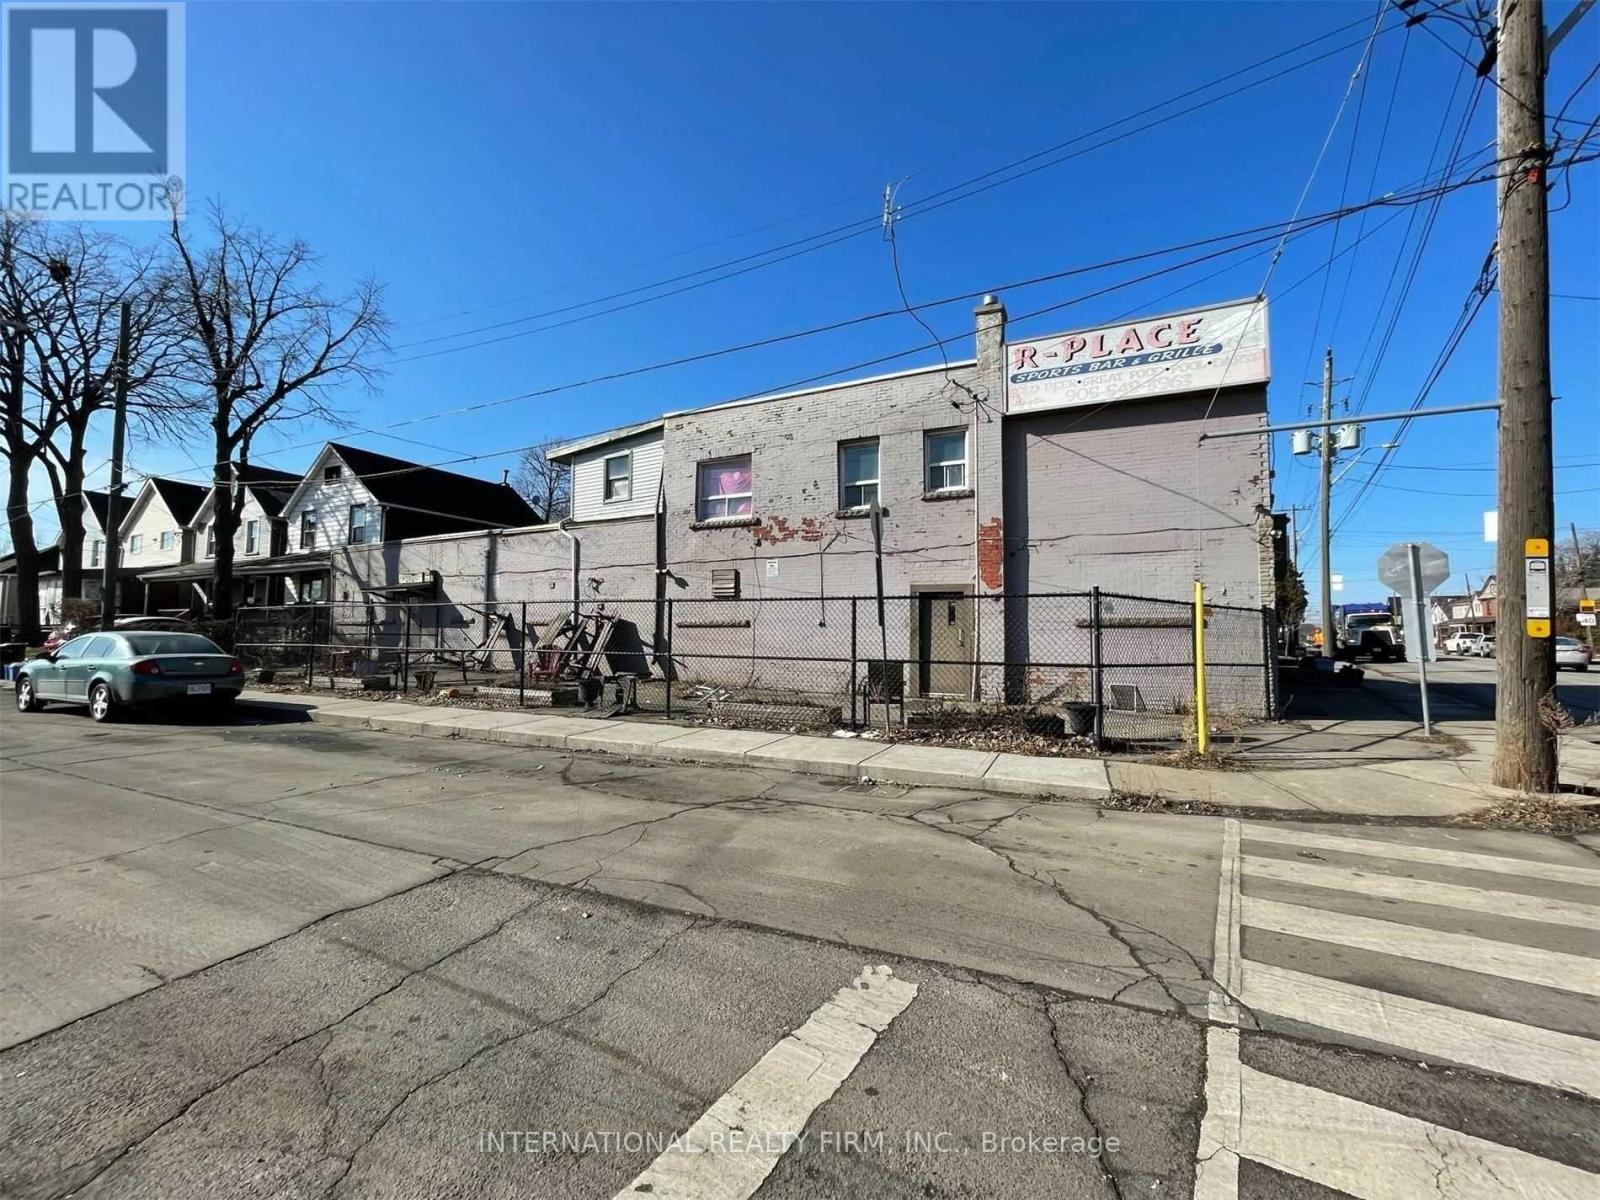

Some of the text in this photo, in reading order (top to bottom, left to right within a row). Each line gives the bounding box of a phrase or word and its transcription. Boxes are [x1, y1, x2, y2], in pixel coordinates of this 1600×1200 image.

[1013, 318, 1204, 370] R-PLACE
[1015, 365, 1083, 383] SPORTS
[1088, 358, 1126, 372] BAR
[1148, 345, 1214, 363] GRILLE
